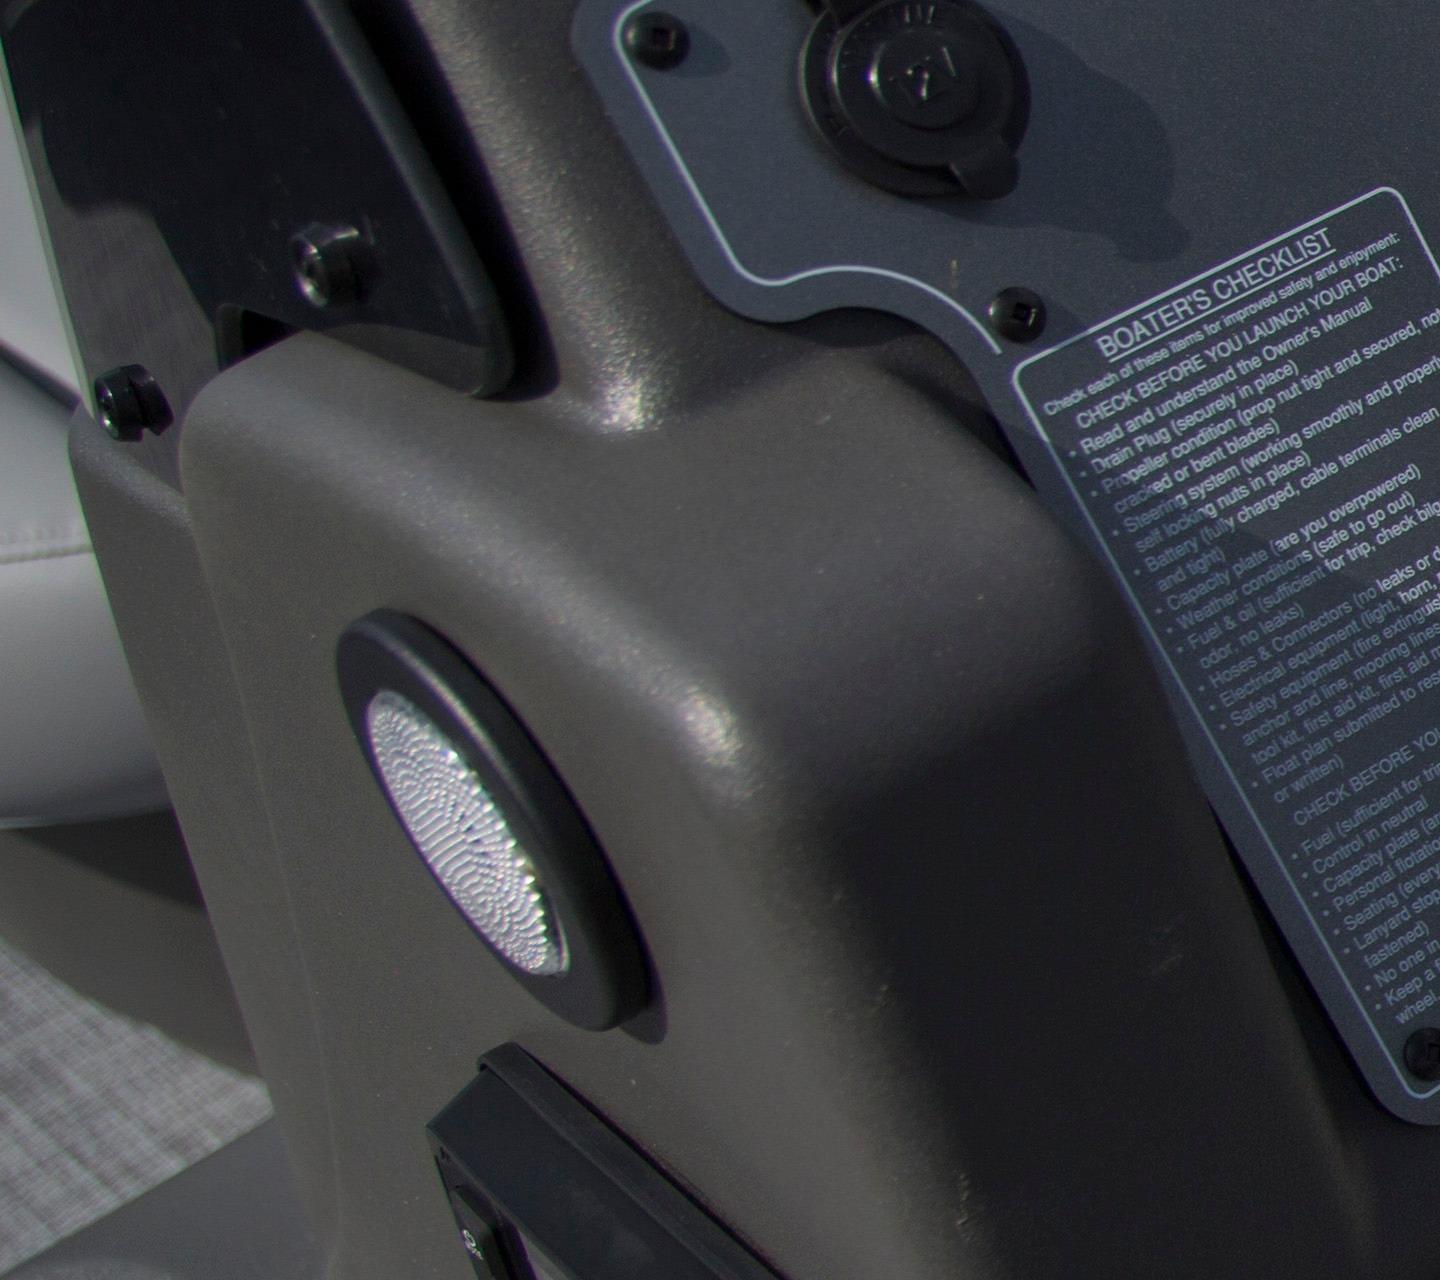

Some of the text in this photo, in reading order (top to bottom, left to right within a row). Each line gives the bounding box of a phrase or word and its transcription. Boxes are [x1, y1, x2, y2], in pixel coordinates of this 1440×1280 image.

[1042, 231, 1401, 416] Check each of these items for improved safety and enjoyment:
[1075, 254, 1404, 430] CHECK BEFORE YOU LAUNCH YOUR BOAT:
[1095, 226, 1334, 358] BOATER'S CHECKLIST
[1079, 295, 1373, 455] Read and understand the Owner's Manual
[1089, 358, 1300, 476] Drain Plug (securely in place)
[1100, 449, 1173, 499] Propeller
[1169, 415, 1237, 459] condition
[1235, 395, 1277, 427] (prop
[1275, 380, 1302, 404] nut
[1299, 364, 1335, 393] tight
[1332, 348, 1362, 374] and
[1360, 319, 1422, 361] secured,
[1111, 416, 1281, 515] cracked or bent blades)
[1123, 490, 1190, 535] Steering
[1185, 463, 1242, 502] system
[1239, 430, 1303, 475] (working
[1300, 397, 1365, 441] smoothly
[1363, 380, 1393, 406] and
[1143, 405, 1440, 574] Battery (fully charged, cable terminals clean
[1165, 462, 1422, 613] Capacity plate (are you overpowered)
[1175, 489, 1416, 631] Weather conditions (safe to go out)
[1292, 783, 1351, 827] CHECK
[1348, 744, 1415, 793] BEFORE
[1321, 847, 1385, 896] Capacity
[1383, 826, 1421, 859] plate
[1373, 966, 1398, 989] No
[1398, 949, 1426, 973] one
